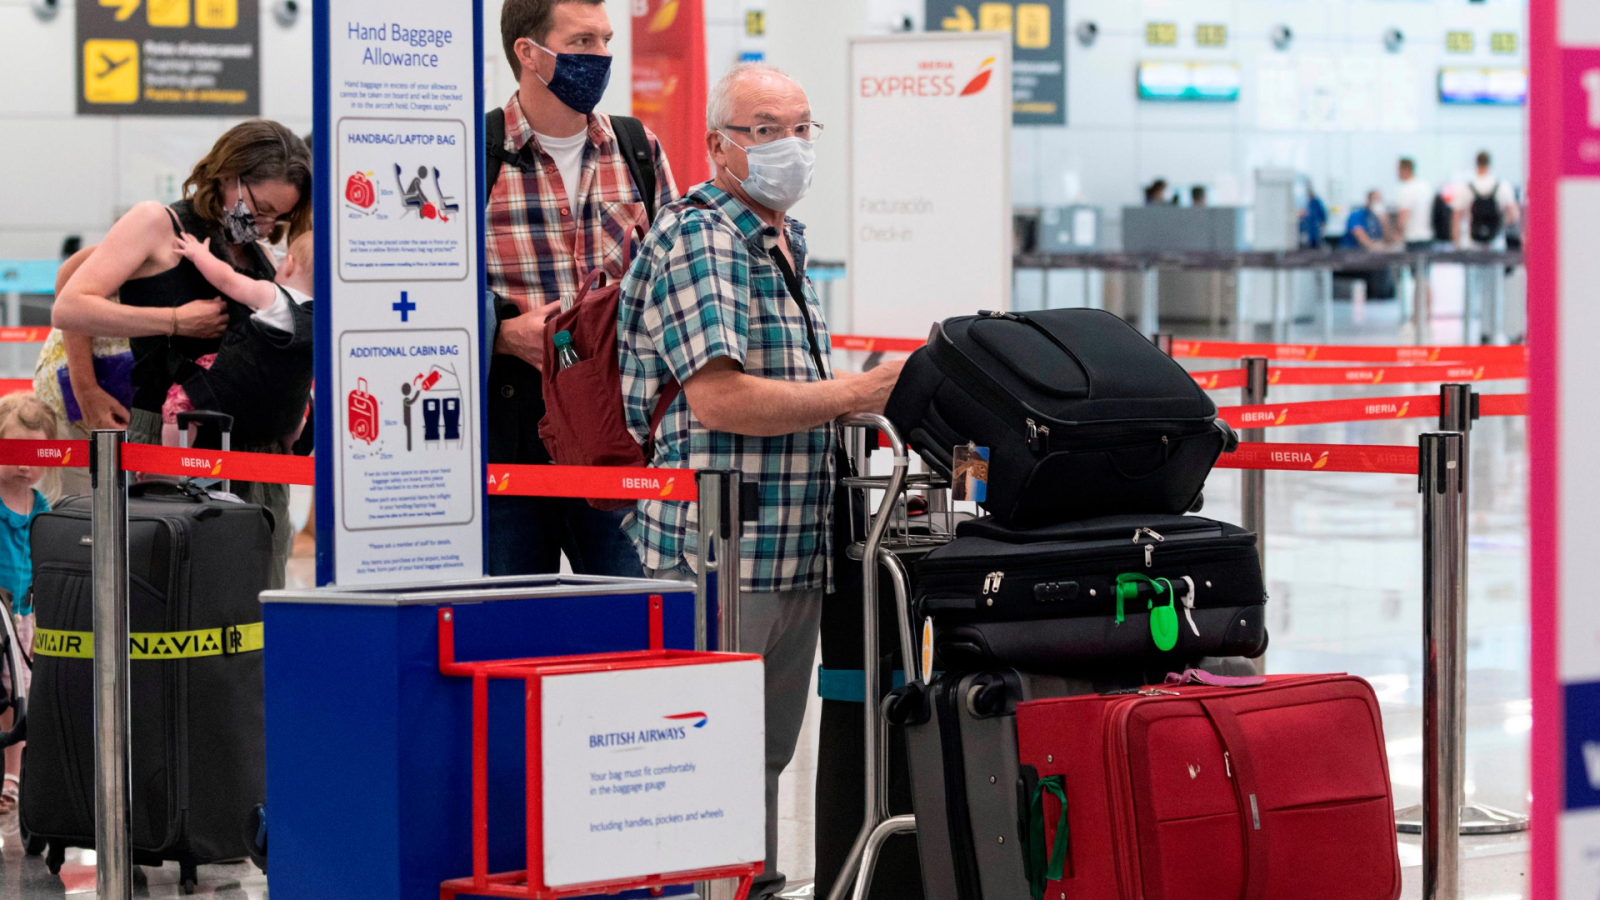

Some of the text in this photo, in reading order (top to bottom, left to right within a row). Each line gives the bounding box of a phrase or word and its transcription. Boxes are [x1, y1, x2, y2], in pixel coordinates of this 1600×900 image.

[348, 22, 453, 48] Hand Baggage
[362, 47, 438, 67] Allowance
[918, 61, 954, 69] IBERIA
[360, 81, 382, 90] baggage
[410, 82, 416, 90] of
[431, 82, 457, 90] allowance
[861, 75, 955, 97] EXPRESS
[421, 92, 430, 100] will
[440, 93, 463, 101] checked
[348, 133, 456, 146] HANDBAG/LAPTOP BAG
[860, 196, 934, 214] Facturación
[860, 225, 913, 242] Check-in
[349, 344, 458, 358] ADDITIONAL CABIN BAG
[1345, 371, 1374, 380] IBERIA
[1447, 368, 1474, 377] IBERIA
[1365, 404, 1397, 414] IBERIA
[1241, 411, 1275, 422] IBERIA
[37, 448, 62, 458] IBERIA
[1271, 451, 1313, 463] IBERIA
[181, 457, 211, 469] IBERIA
[622, 477, 660, 489] IBERIA
[589, 727, 686, 748] BRITISH AIRWAYS
[590, 772, 607, 782] Your
[609, 770, 623, 781] bag
[624, 767, 643, 778] must
[653, 762, 696, 776] comfortably
[590, 780, 667, 796] in the baggage gauge
[590, 808, 724, 833] Including handles, pockets and wheels
